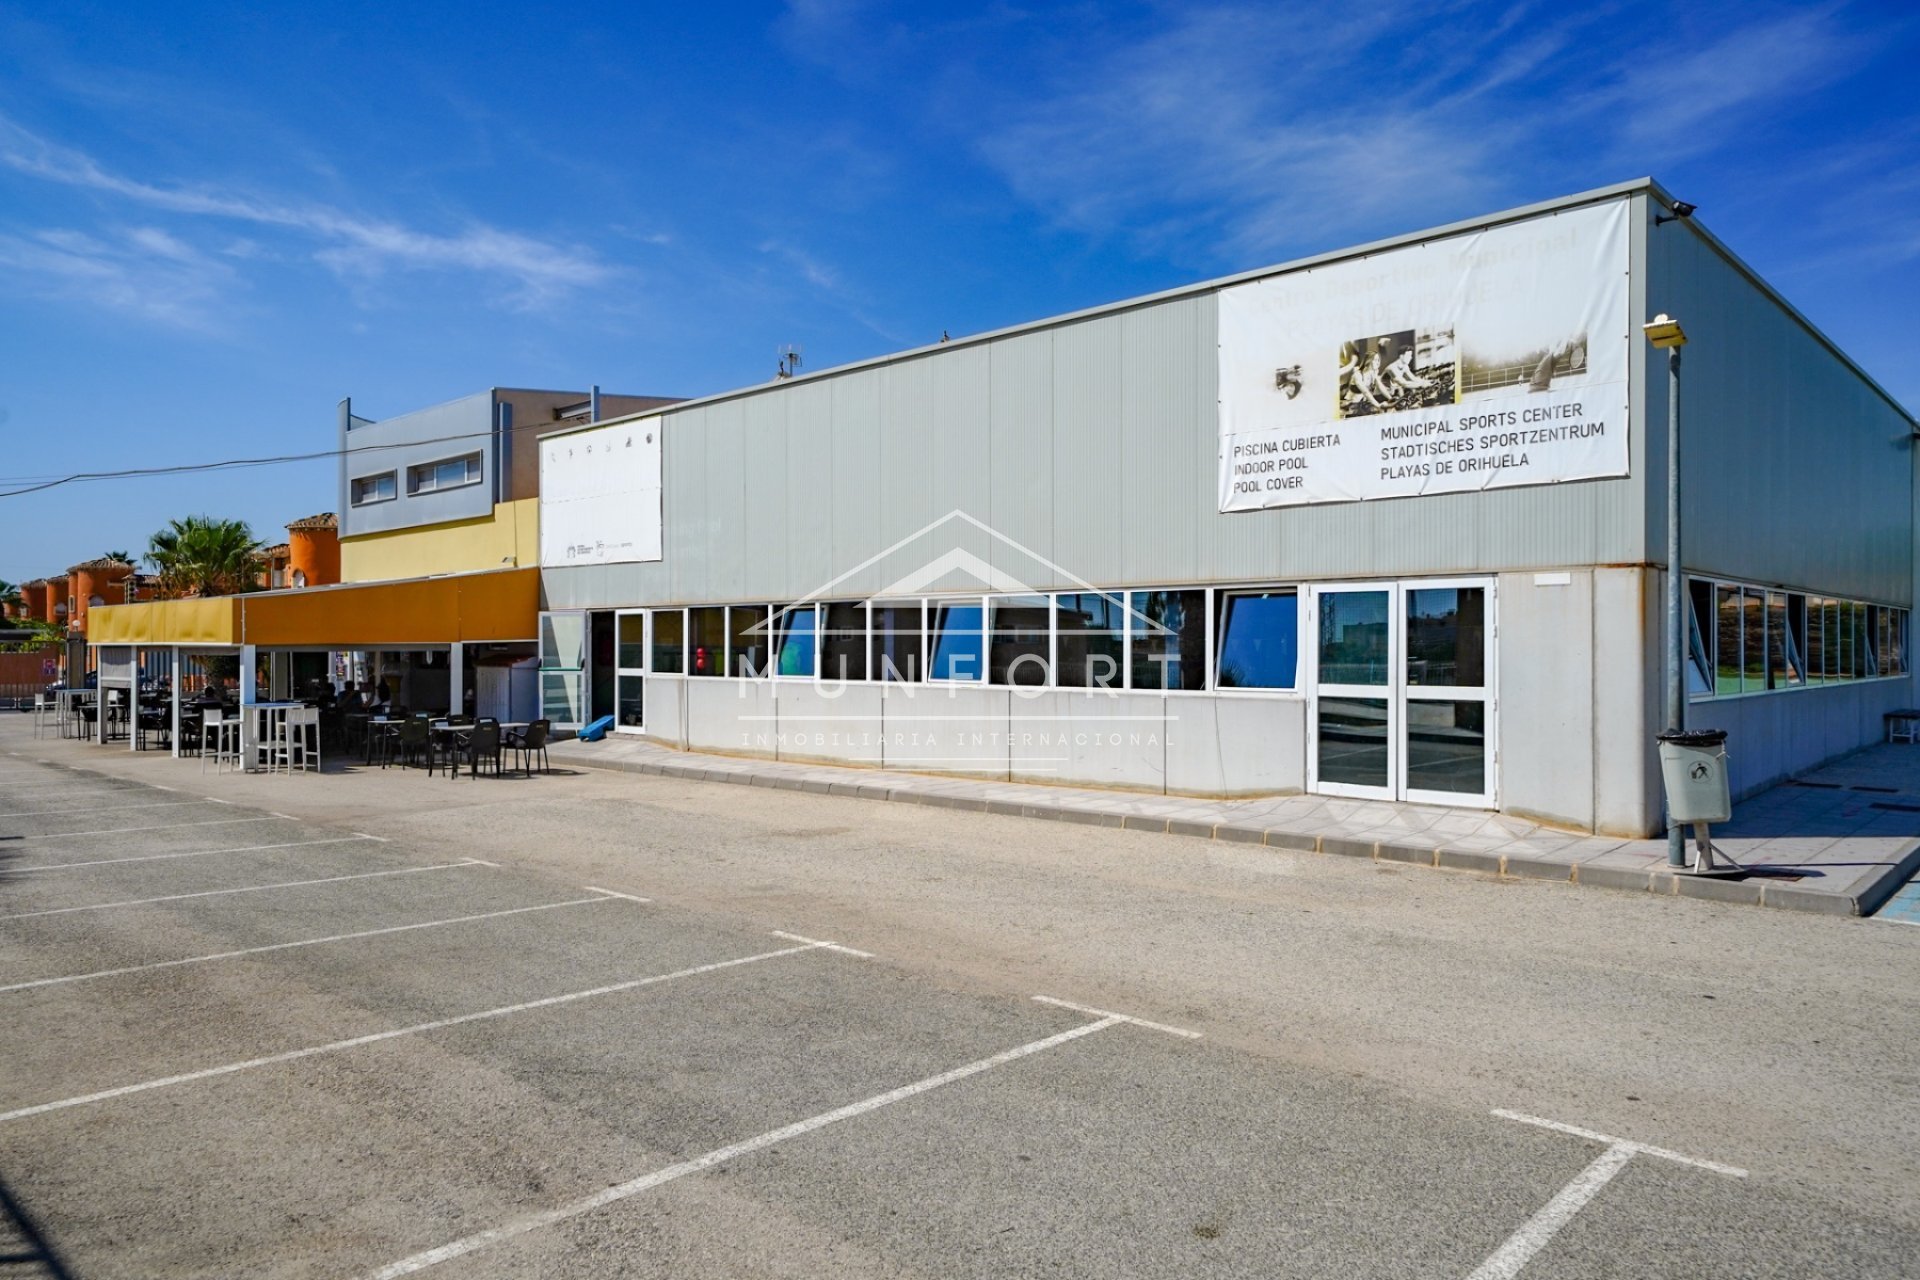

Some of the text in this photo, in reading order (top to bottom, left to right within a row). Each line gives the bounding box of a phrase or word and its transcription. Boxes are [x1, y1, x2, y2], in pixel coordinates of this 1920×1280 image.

[1381, 402, 1583, 441] MUNICIPAL SPORTS CENTER
[1234, 434, 1340, 458] PISCINA CUBIERTA
[1381, 421, 1605, 461] STADTISCHES SPORTZENTRUM
[1234, 457, 1308, 476] INDOOR POOL
[1381, 452, 1530, 480] PLAYAS DE ORIHUELA
[1234, 476, 1304, 494] POOL COVER
